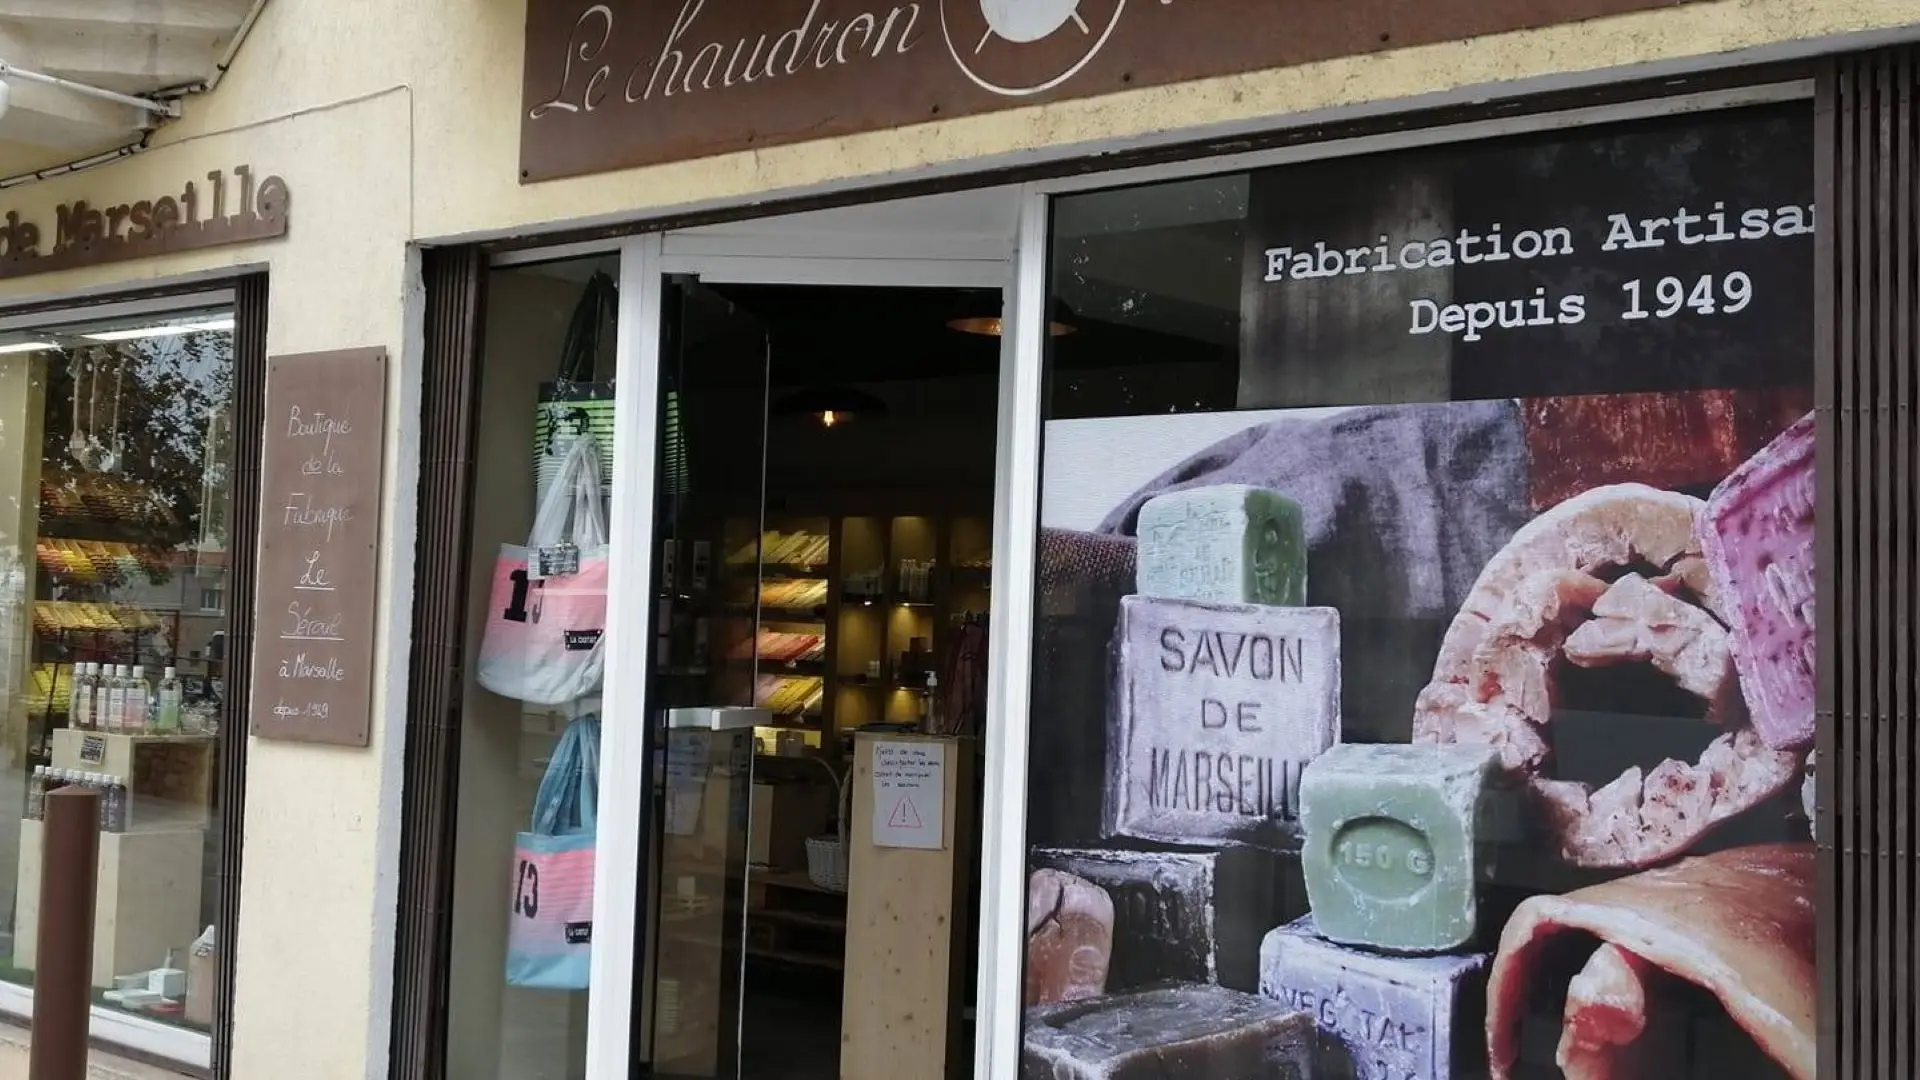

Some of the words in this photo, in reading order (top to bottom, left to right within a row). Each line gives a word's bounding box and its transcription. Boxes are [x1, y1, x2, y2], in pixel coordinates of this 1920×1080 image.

[528, 3, 611, 120] Le
[625, 0, 922, 104] chaudron
[53, 164, 288, 253] Marseille
[1263, 223, 1574, 282] Fabrication
[1409, 287, 1586, 342] Depuis
[1621, 271, 1752, 321] 1949
[287, 404, 353, 456] Boutique
[300, 550, 331, 585] Le
[1159, 626, 1304, 683] SAVON
[1201, 698, 1263, 733] DE
[1150, 746, 1303, 821] MARSEILL
[1340, 841, 1394, 869] 150
[1406, 848, 1434, 876] G
[513, 860, 539, 919] 13
